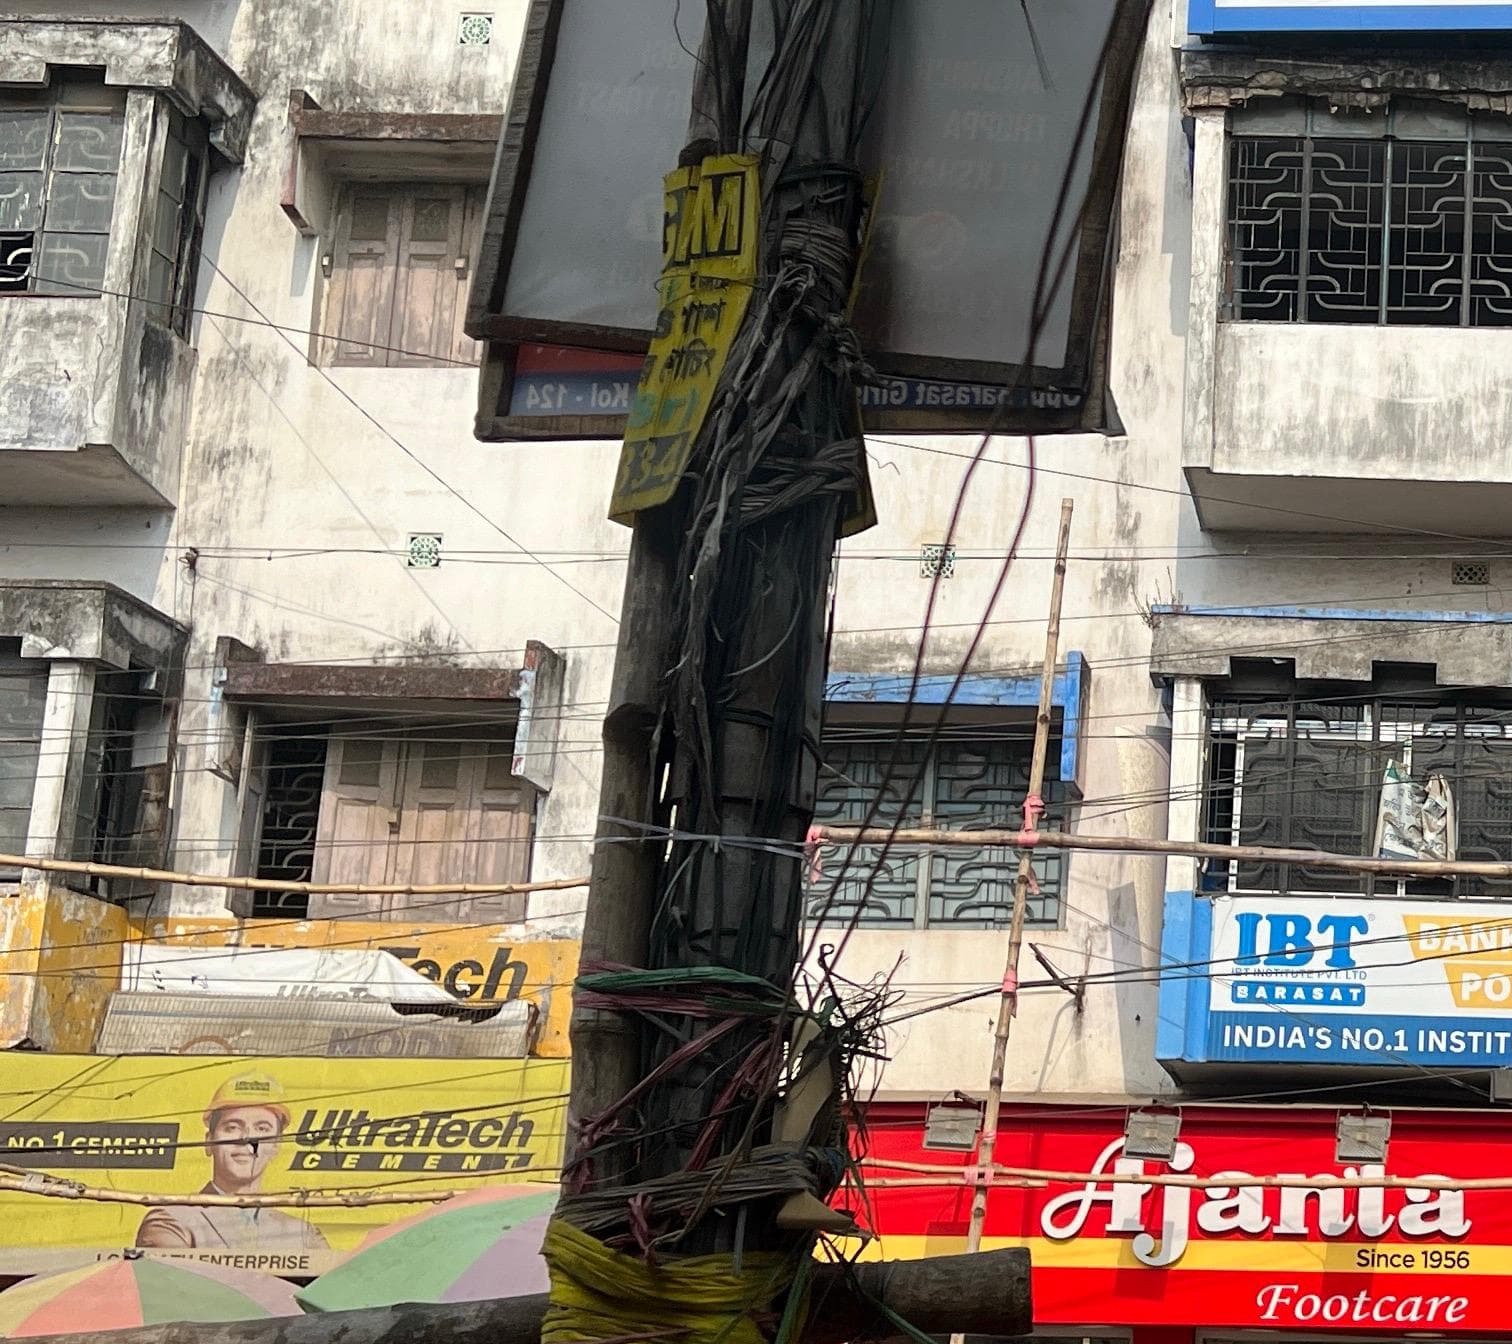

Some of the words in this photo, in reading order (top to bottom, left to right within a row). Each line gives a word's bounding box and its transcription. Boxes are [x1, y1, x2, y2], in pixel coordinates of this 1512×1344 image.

[1232, 912, 1368, 968] IBT
[1345, 970, 1368, 980] LTD
[1236, 985, 1362, 1001] BARASAT
[1222, 1024, 1332, 1050] INDIA'S
[1341, 1027, 1408, 1053] NO.1
[297, 1109, 535, 1148] UltraTech
[71, 1136, 170, 1156] CEMENT
[302, 1152, 521, 1170] CEMENT
[1041, 1135, 1473, 1267] Ajanta
[1356, 1248, 1416, 1269] Since
[1421, 1250, 1471, 1270] 1956
[1256, 1283, 1469, 1323] Footcare
